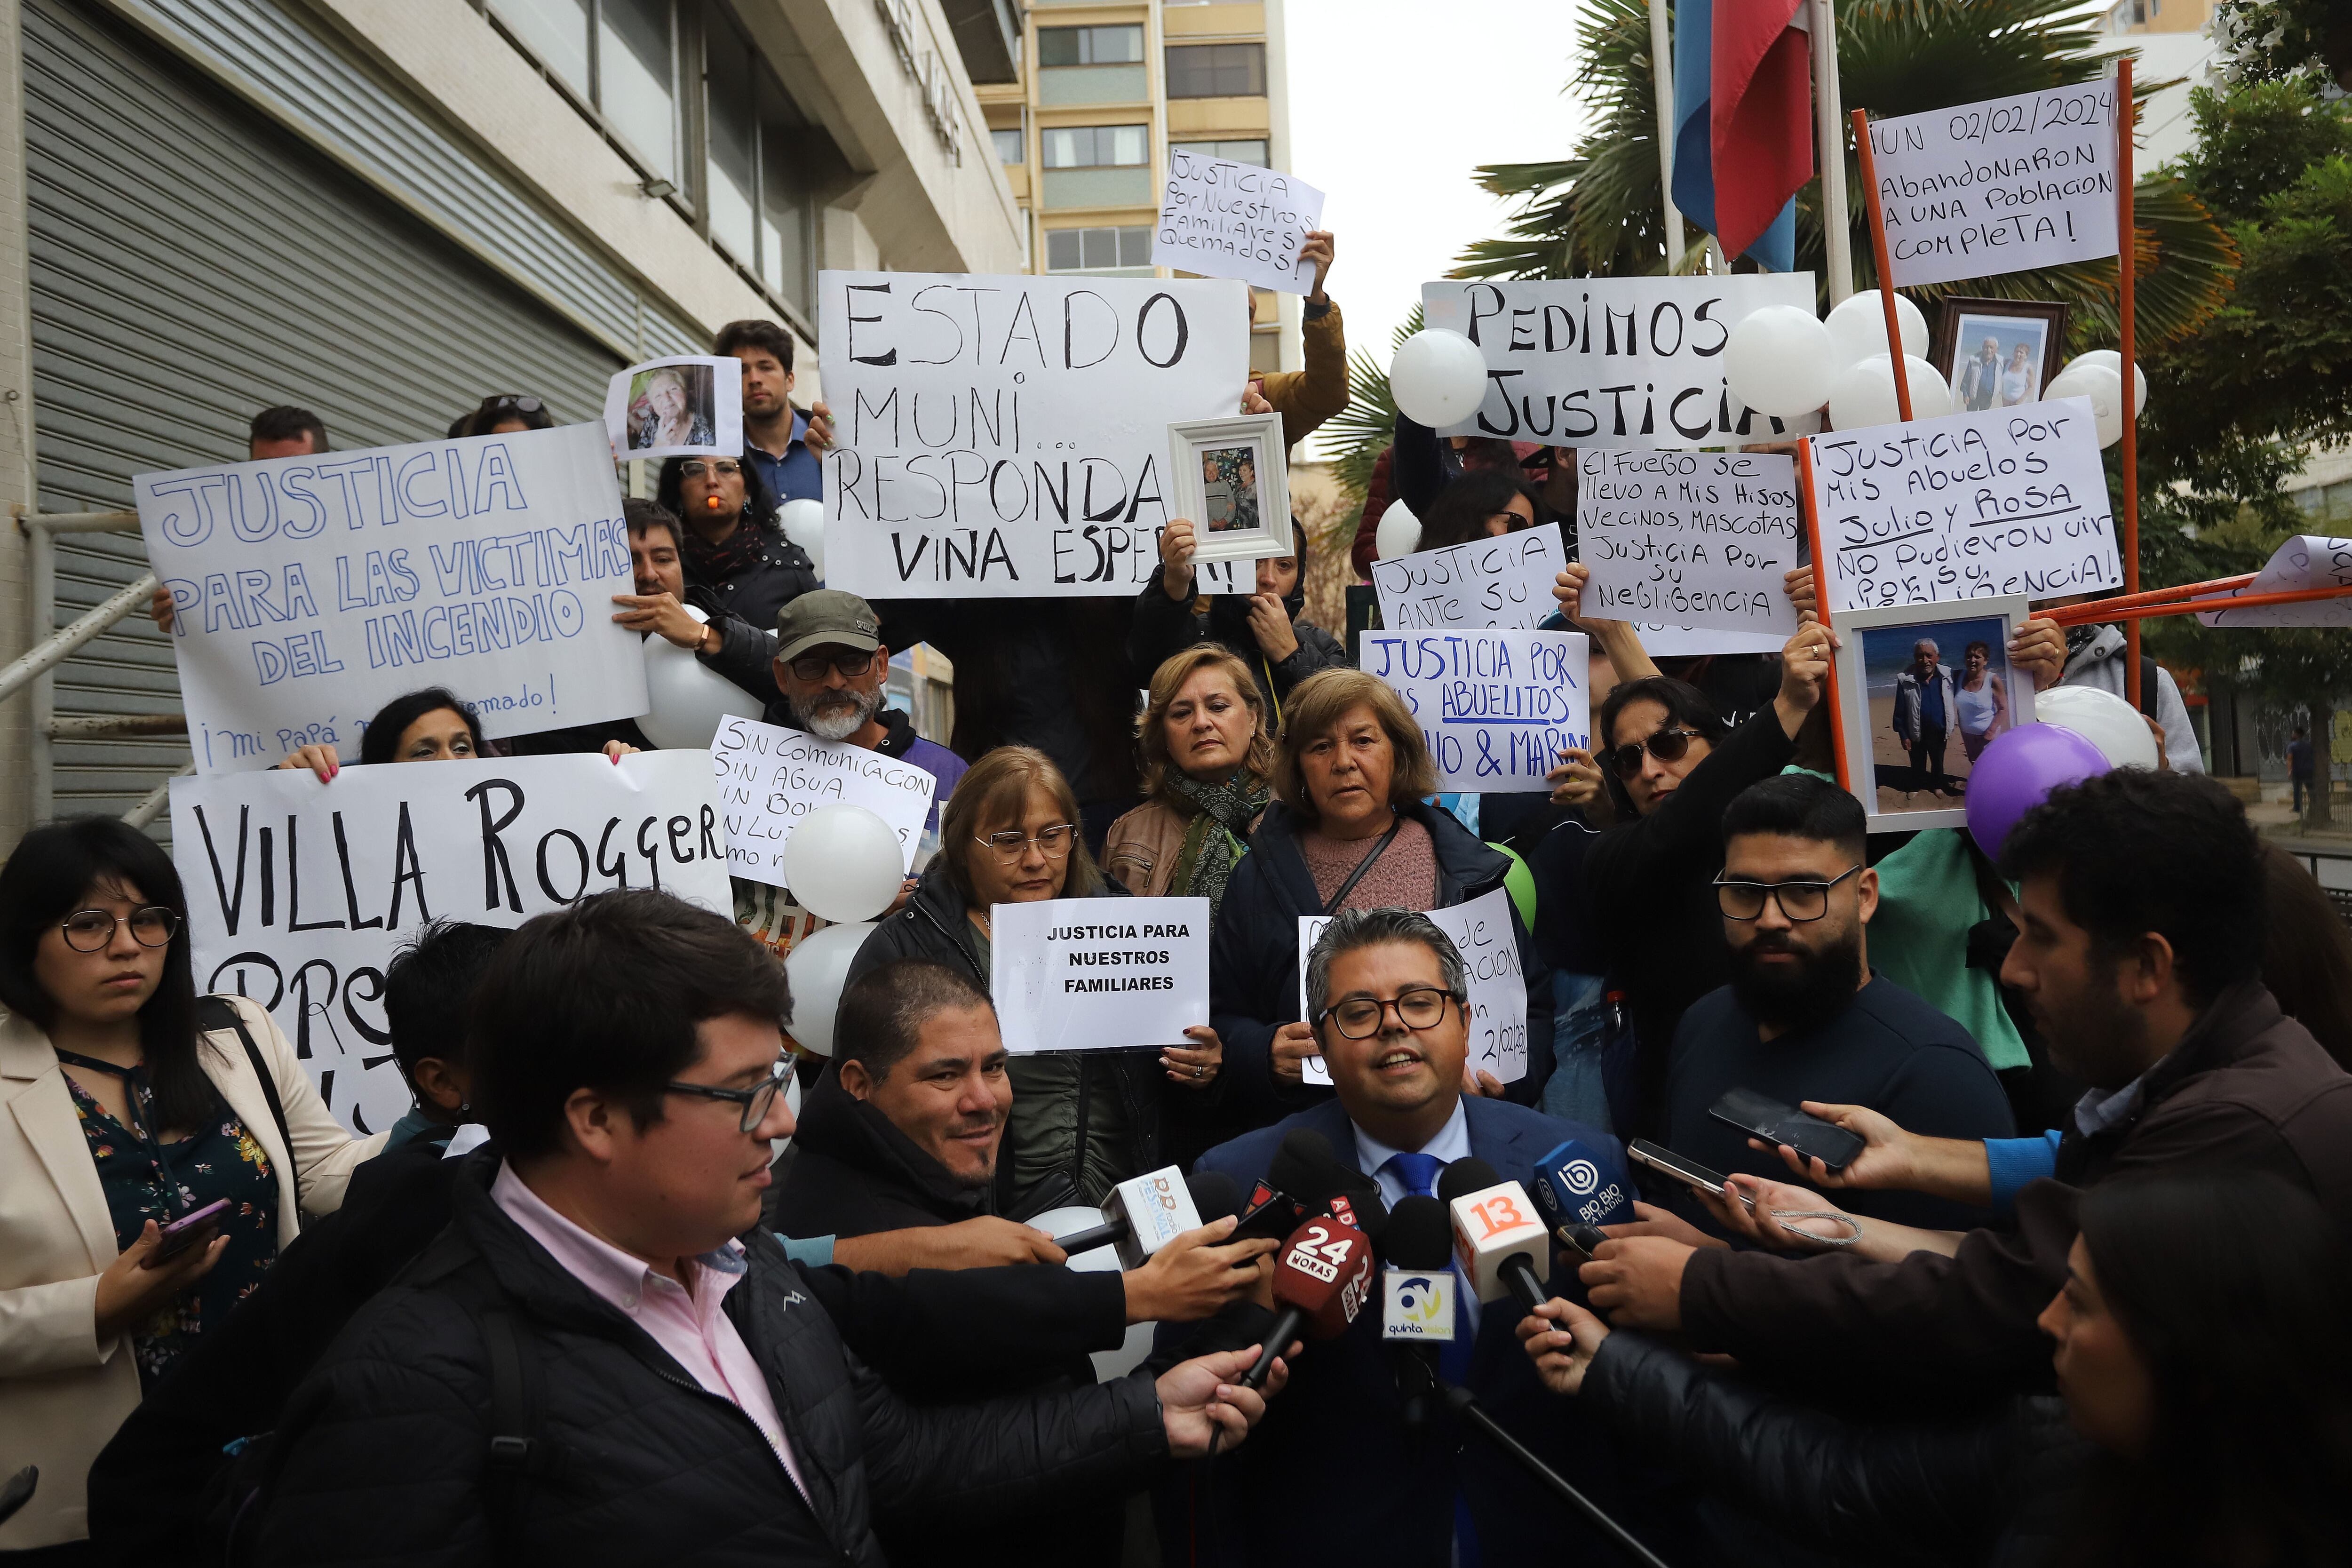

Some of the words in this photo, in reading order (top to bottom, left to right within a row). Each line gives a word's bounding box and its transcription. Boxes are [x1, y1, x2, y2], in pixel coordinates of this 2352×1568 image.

[1950, 92, 2112, 143] 02/02/2024
[1166, 181, 1197, 209] Por
[1885, 208, 1901, 230] A
[1912, 199, 1966, 221] UNA
[847, 282, 1188, 369] ESTADO
[1583, 451, 1606, 476] El
[151, 443, 527, 547] JUSTICIA
[830, 449, 1168, 524] RESPONDA
[1654, 487, 1667, 500] A
[1840, 506, 1933, 544] Julio
[162, 563, 318, 637] PARA
[336, 548, 420, 613] LAS
[429, 517, 632, 597] VICTIMAS
[1836, 553, 1878, 580] NO
[1480, 582, 1528, 612] SU
[252, 630, 344, 686] DEL
[366, 589, 584, 669] INCENDIO
[1370, 636, 1512, 680] JUSTICIA
[1531, 642, 1577, 688] POR
[467, 673, 557, 716] emado!
[1442, 680, 1569, 724] ABUELITOS
[1476, 729, 1502, 777] &
[192, 801, 431, 937] VILLA
[1048, 925, 1137, 940] JUSTICIA
[1143, 924, 1190, 939] PARA
[1069, 950, 1170, 966] NUESTROS
[1064, 976, 1174, 993] FAMILIARES
[1332, 1200, 1358, 1229] AD
[1470, 1197, 1532, 1239] 13
[1579, 1199, 1600, 1223] BIO
[1598, 1183, 1620, 1205] BIO
[1598, 1194, 1624, 1219] RADIO
[1291, 1254, 1333, 1278] HORAS
[1295, 1226, 1353, 1266] 24
